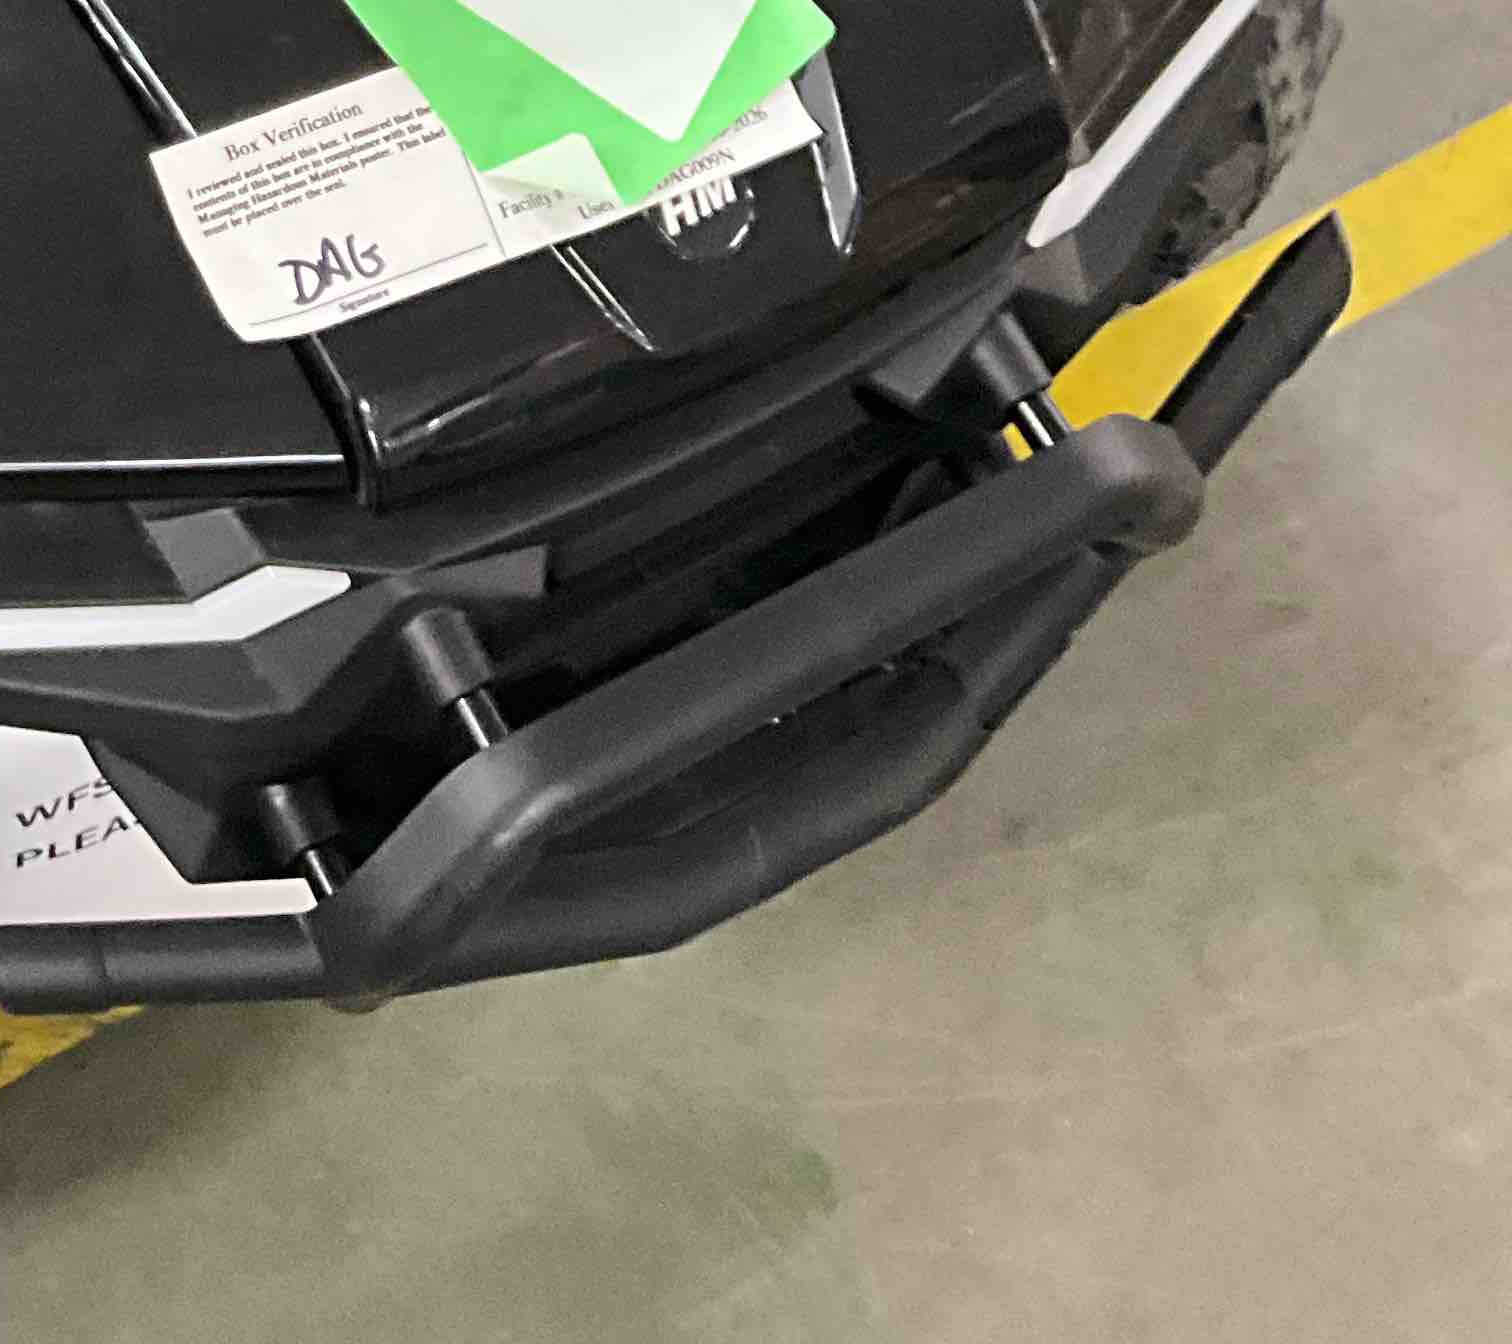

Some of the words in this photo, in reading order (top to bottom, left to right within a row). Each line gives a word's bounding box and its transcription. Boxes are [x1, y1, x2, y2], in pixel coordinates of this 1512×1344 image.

[196, 172, 242, 196] reviewed
[244, 164, 264, 178] and
[298, 147, 318, 159] this
[393, 111, 414, 124] that
[224, 142, 260, 161] Box
[262, 105, 363, 145] Verification
[250, 179, 271, 190] this
[272, 171, 291, 182] box
[382, 129, 405, 142] with
[407, 124, 423, 134] the
[308, 161, 358, 182] Materials
[397, 139, 420, 151] This
[422, 128, 446, 143] label
[281, 196, 302, 208] over
[305, 189, 321, 199] the
[498, 189, 554, 219] Facility
[277, 233, 386, 305] DAG
[15, 814, 142, 869] PLEA
